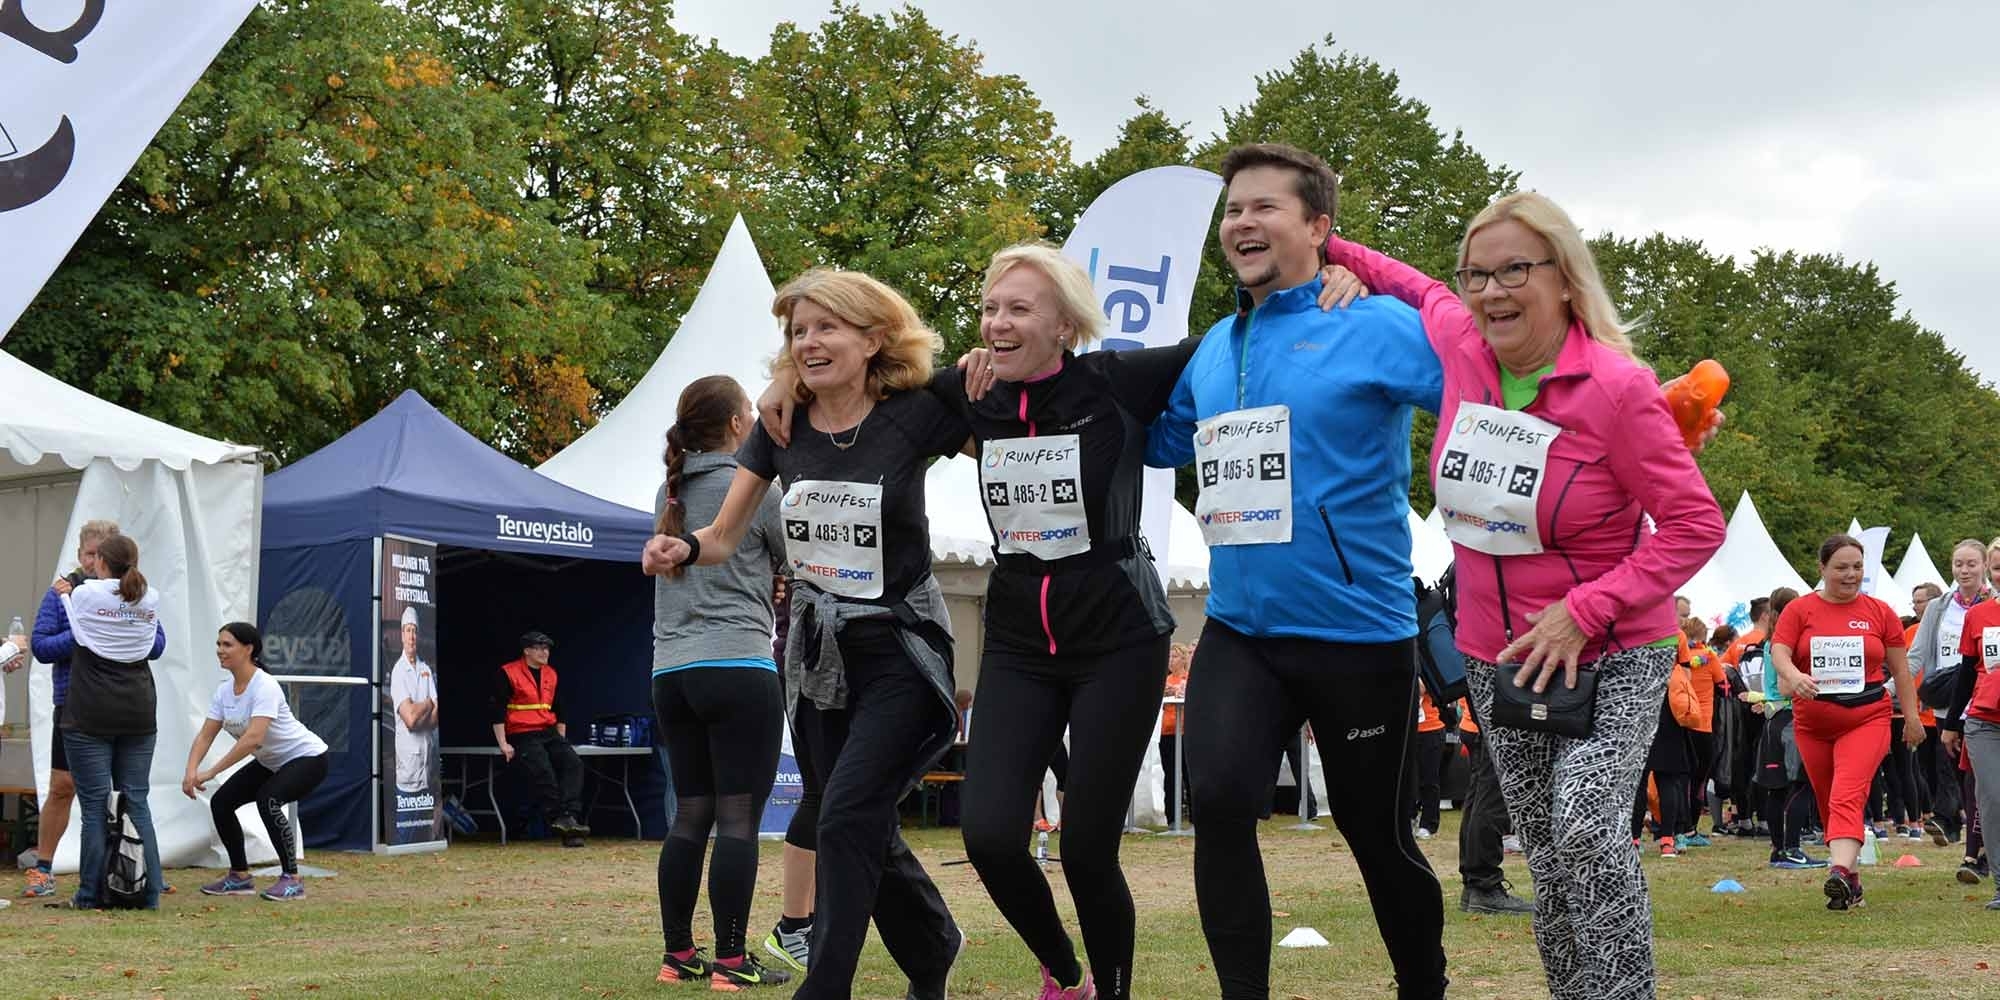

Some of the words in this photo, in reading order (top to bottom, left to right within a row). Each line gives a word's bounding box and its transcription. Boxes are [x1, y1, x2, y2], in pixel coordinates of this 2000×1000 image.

[1217, 420, 1286, 442] RUNFEST
[1473, 419, 1549, 445] RUNFEST
[1003, 448, 1075, 466] RUNFEST
[1223, 458, 1254, 480] 485-5
[1469, 460, 1506, 487] 485-1
[805, 492, 877, 508] RUNFEST
[1014, 484, 1047, 503] 485-2
[1213, 509, 1282, 523] INTERSPORT
[1456, 512, 1528, 534] INTERSPORT
[496, 515, 593, 544] Terveystalo
[815, 524, 849, 542] 485-3
[1010, 527, 1080, 541] INTERSPORT
[806, 564, 874, 580] INTERSPORT
[1848, 620, 1869, 630] CGI
[1827, 656, 1847, 667] 373-1
